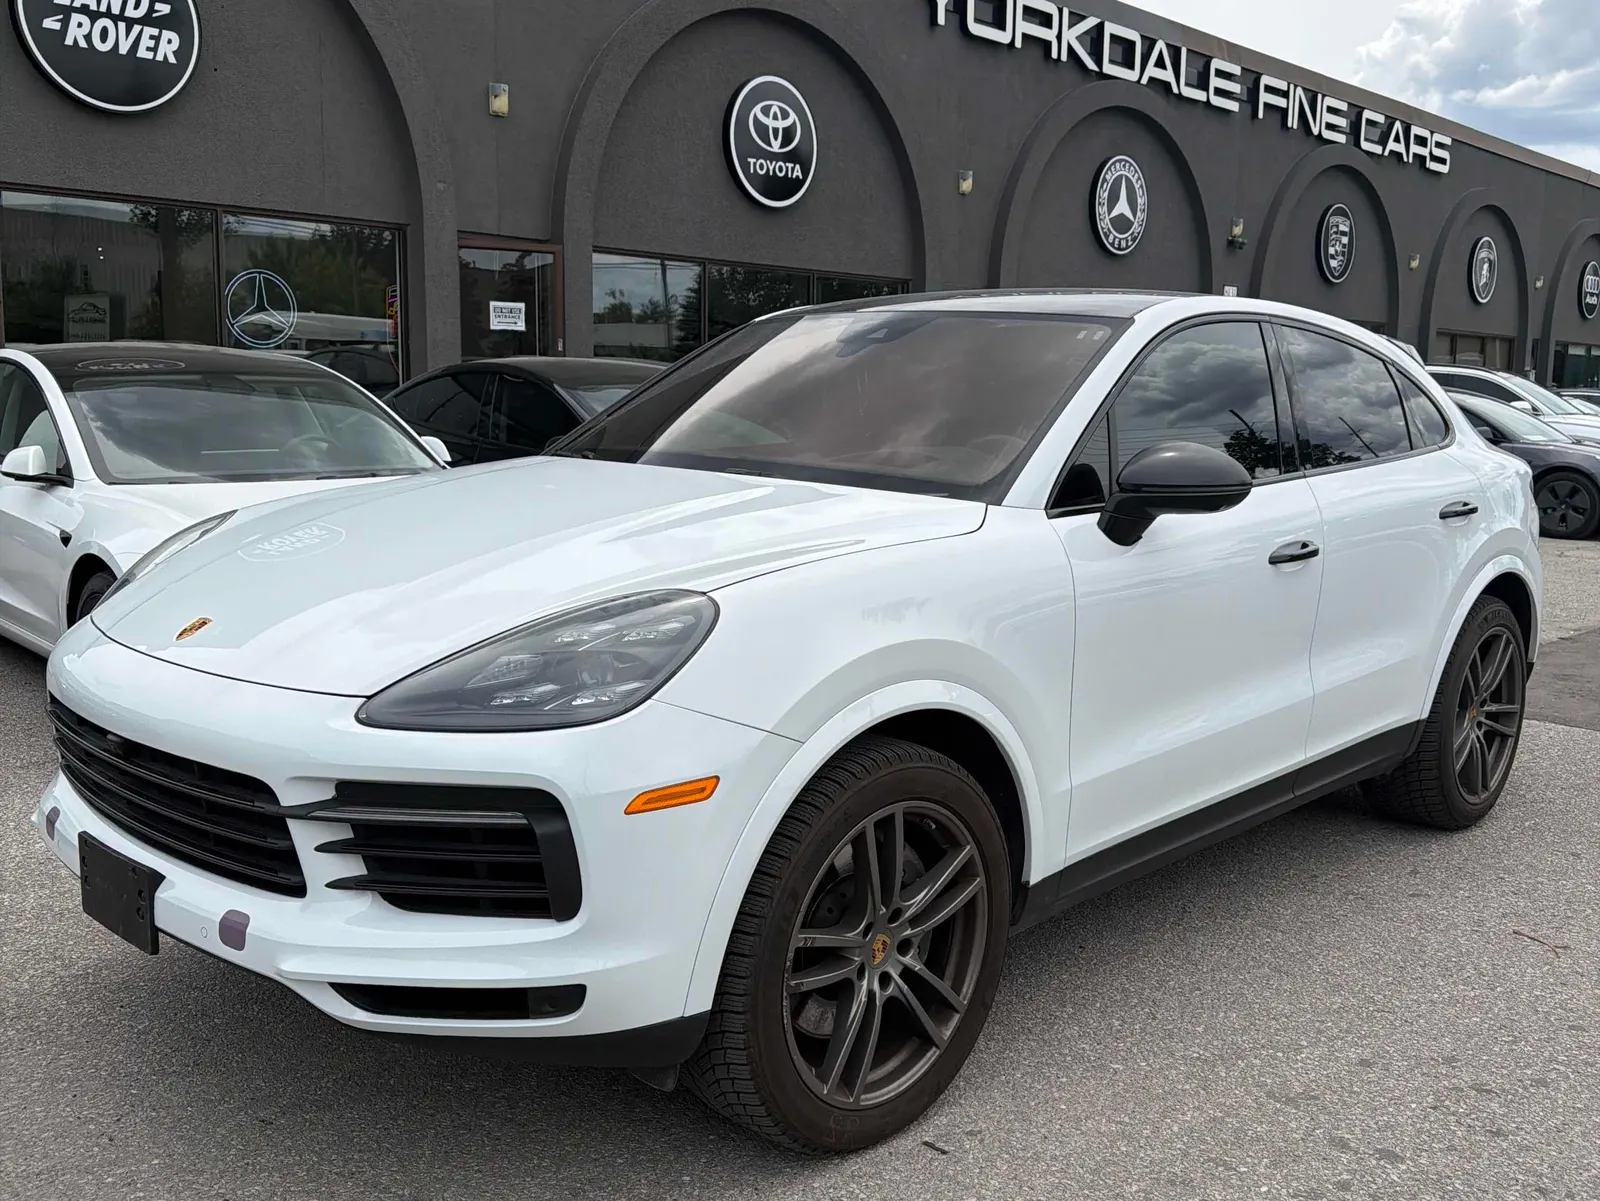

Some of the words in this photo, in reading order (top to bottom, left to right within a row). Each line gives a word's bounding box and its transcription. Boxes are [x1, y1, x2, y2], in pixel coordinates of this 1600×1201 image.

[64, 12, 180, 64] ROVER
[1257, 74, 1348, 144] FINE
[1360, 109, 1452, 174] CARS
[747, 158, 803, 179] TOYOTA
[1105, 161, 1142, 189] MERCEDES
[1108, 233, 1133, 249] BENZ
